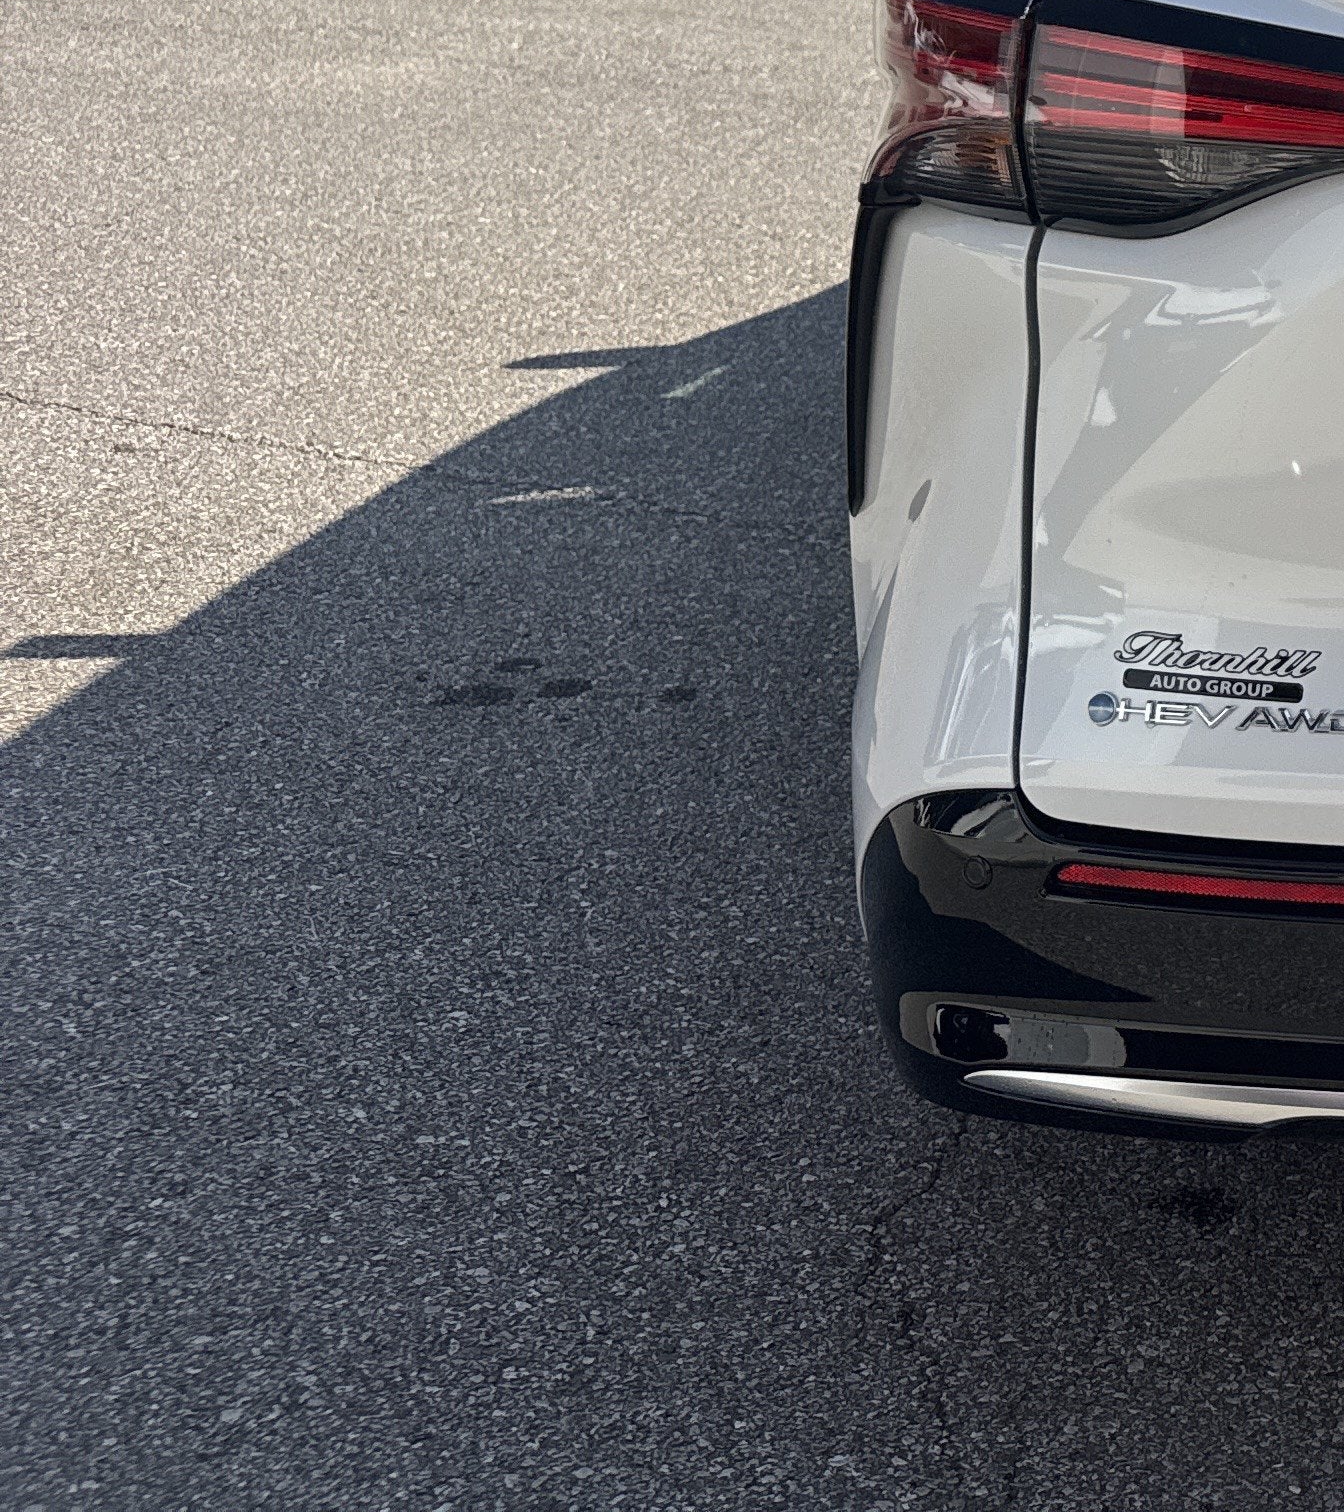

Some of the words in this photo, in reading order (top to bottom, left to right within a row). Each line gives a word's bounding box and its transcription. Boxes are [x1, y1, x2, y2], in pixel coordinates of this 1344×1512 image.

[1113, 630, 1323, 679] Thornhill
[1149, 673, 1201, 693] AUTO
[1205, 679, 1275, 699] GROUP
[1115, 698, 1236, 730] HEV
